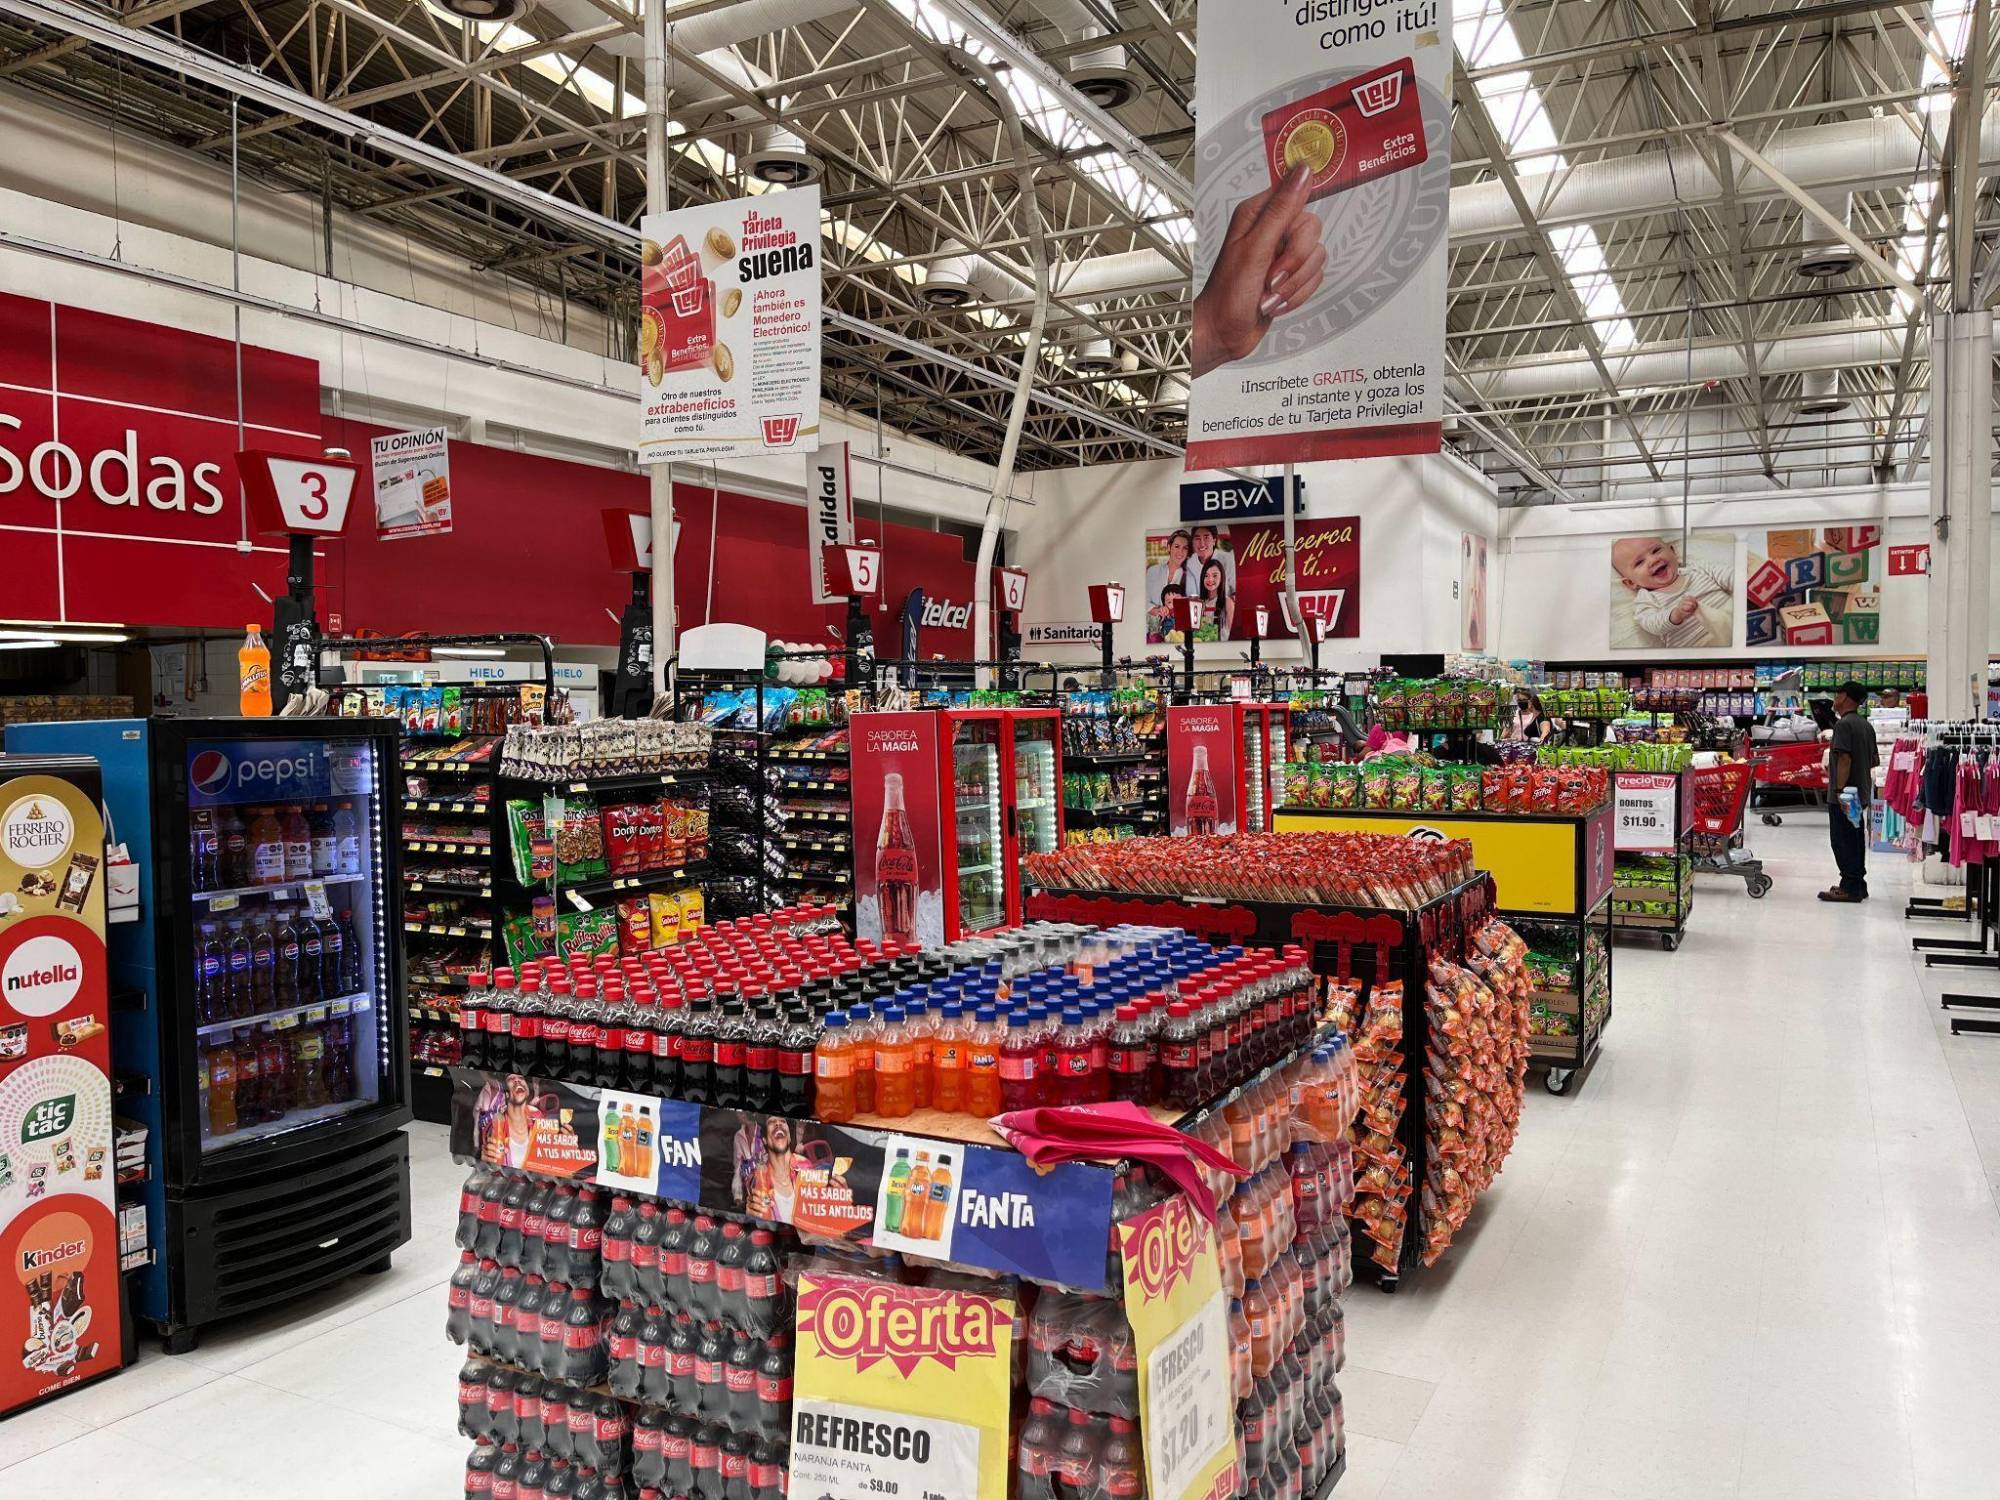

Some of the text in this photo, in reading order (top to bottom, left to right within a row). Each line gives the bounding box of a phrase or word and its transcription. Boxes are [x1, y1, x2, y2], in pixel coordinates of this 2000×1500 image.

[1296, 0, 1402, 26] disting
[1320, 20, 1386, 50] como
[1383, 133, 1415, 151] Extra
[1358, 144, 1416, 172] Beneficios
[748, 211, 757, 221] La
[742, 217, 782, 235] Tarjeta
[742, 230, 796, 251] Privilegia
[738, 243, 813, 283] suena
[753, 288, 785, 303] ¡Ahora
[753, 299, 805, 314] también es
[753, 312, 801, 326] Monedero
[687, 334, 707, 344] Extra
[753, 322, 811, 338] Electrónico!
[1313, 369, 1368, 387] GRATIS,
[1373, 363, 1425, 380] obtenla
[661, 388, 722, 400] Otro de nuestros
[1281, 382, 1425, 407] al instante y goza los
[647, 398, 736, 416] extrabeneficios
[645, 409, 737, 426] para clientes distinguidos
[1202, 401, 1424, 432] beneficios de tu Tarjeta Privilegia!
[674, 424, 694, 434] como
[374, 429, 444, 453] TU OPINIÓN
[0, 413, 224, 515] Sodas
[375, 459, 390, 467] Buzón
[398, 454, 428, 465] Sugerencias
[300, 471, 328, 519] 3
[1204, 485, 1274, 511] BBVA
[818, 466, 838, 546] alidad
[1239, 526, 1352, 566] Más cerca
[858, 556, 871, 586] 5
[1269, 563, 1287, 584] de
[1009, 579, 1018, 604] 6
[1112, 591, 1120, 614] 7
[921, 597, 973, 630] telcel
[1043, 626, 1103, 639] Sanitario
[469, 667, 504, 679] HIELO
[553, 668, 583, 679] HIELO
[1180, 717, 1219, 726] SABOREA
[867, 730, 917, 741] SABOREA
[867, 741, 919, 752] LA MAGIA
[238, 752, 316, 786] pepsi
[1618, 776, 1651, 786] Precio
[1620, 800, 1653, 808] DORITOS
[9, 819, 64, 837] FERRERO
[1623, 816, 1656, 827] $11.90
[9, 833, 65, 848] ROCHER
[7, 964, 77, 990] nutella
[36, 1102, 66, 1121] tic
[28, 1115, 65, 1137] tac
[536, 1119, 559, 1130] PONLE
[537, 1132, 578, 1147] MÁS SABOR
[537, 1148, 596, 1162] A TUS ANTOJOS
[661, 1136, 702, 1167] FAN
[800, 1170, 829, 1182] PONLE
[800, 1185, 853, 1201] MÁS SABOR
[802, 1203, 873, 1220] A TUS ANTOJOS
[961, 1189, 1035, 1229] FANTA
[23, 1239, 85, 1270] Kinder
[823, 1293, 988, 1349] Oferta
[39, 1374, 80, 1396] COME BIEN
[797, 1412, 931, 1464] REFRESCO
[794, 1453, 873, 1474] NARANJA FANTA
[829, 1476, 840, 1485] ML
[858, 1479, 898, 1495] de $9.00
[923, 1491, 929, 1500] A
